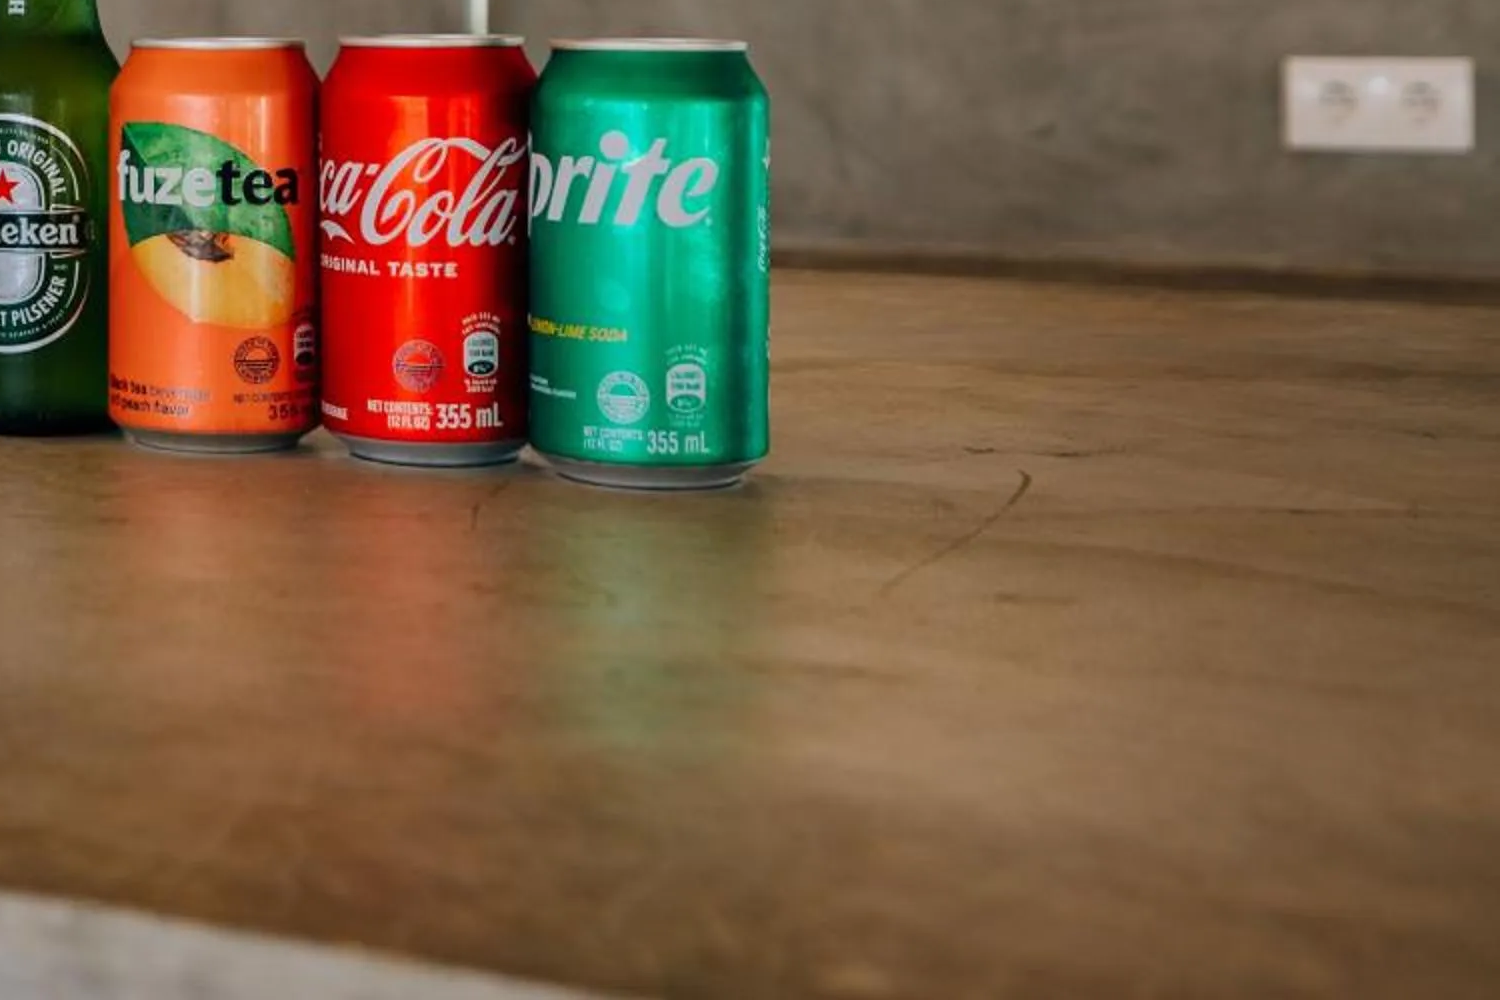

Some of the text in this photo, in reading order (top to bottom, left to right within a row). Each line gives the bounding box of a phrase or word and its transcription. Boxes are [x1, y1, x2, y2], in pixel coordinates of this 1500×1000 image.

[7, 139, 67, 197] ORIGINAL
[320, 137, 526, 247] ca-Cola
[527, 129, 719, 229] prite
[321, 253, 459, 279] RIGINAL TASTE
[11, 275, 67, 327] PILSENER
[435, 402, 504, 429] 355 mL
[647, 431, 711, 454] 355 mL
